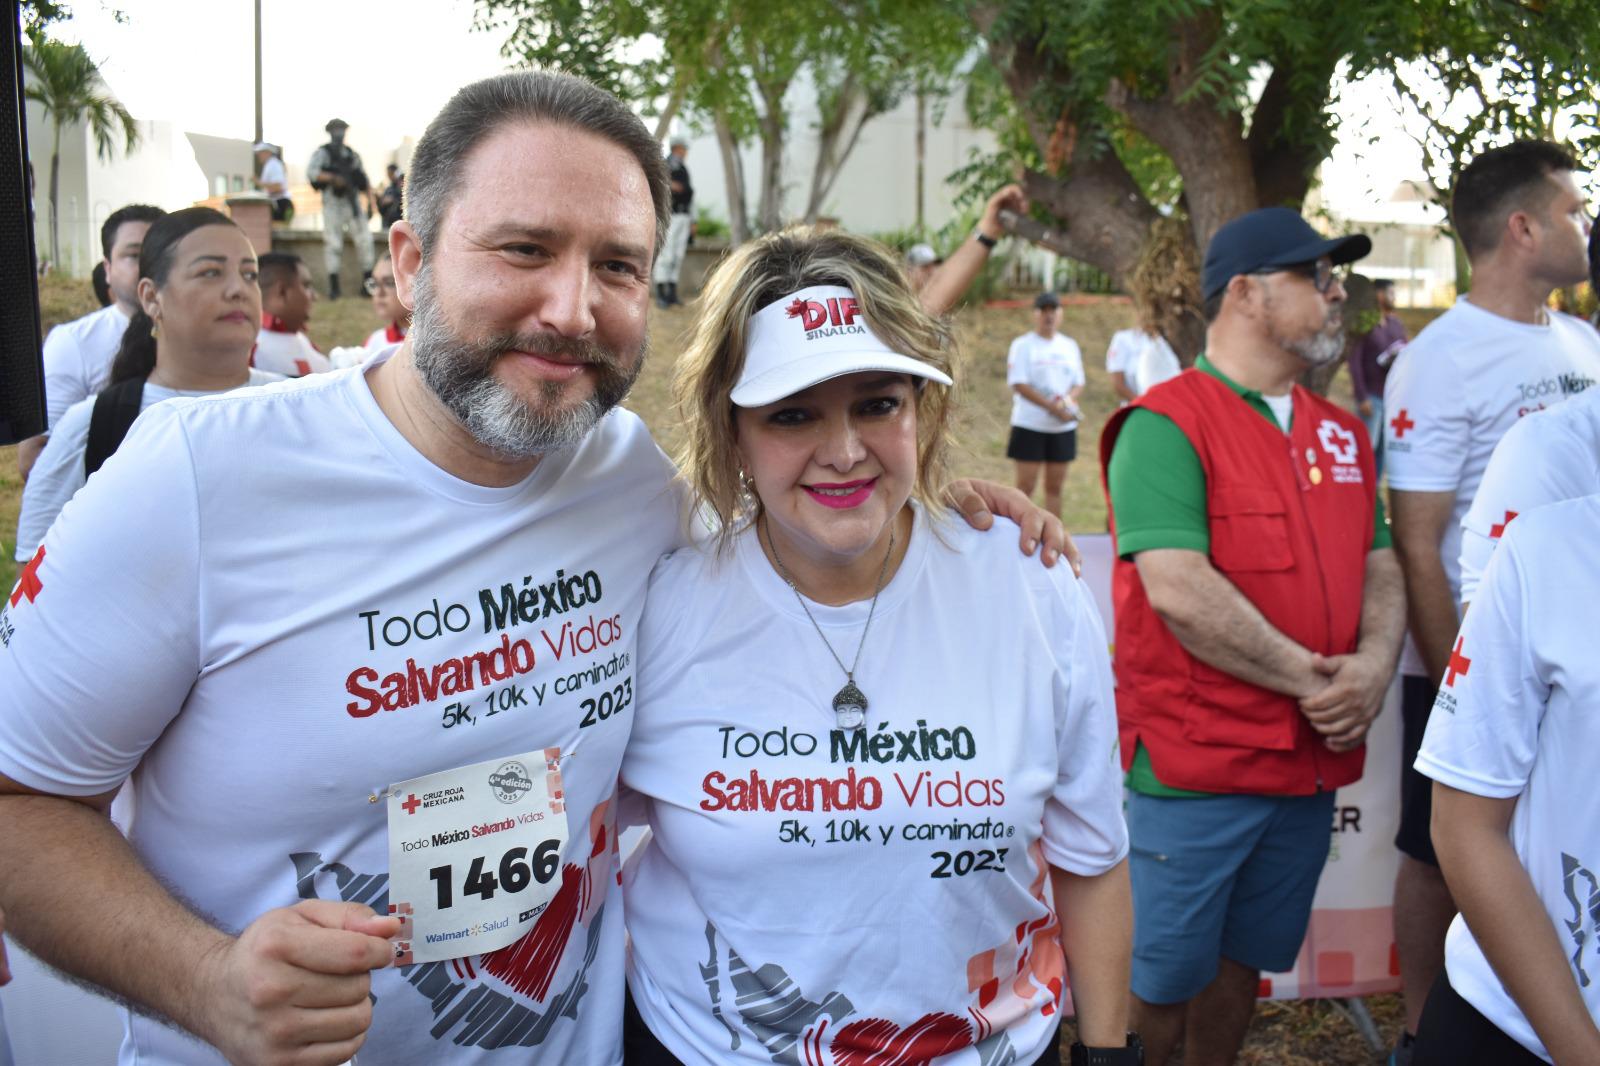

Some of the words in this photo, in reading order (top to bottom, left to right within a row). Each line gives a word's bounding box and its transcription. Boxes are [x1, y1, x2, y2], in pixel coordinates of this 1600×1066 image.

[800, 297, 864, 332] DIF
[806, 326, 866, 341] SINALOA
[359, 598, 470, 650] Todo
[478, 569, 602, 634] México
[345, 634, 536, 718] Salvando
[541, 613, 621, 661] Vidas
[442, 702, 478, 729] 5k,
[485, 685, 529, 717] 10k
[532, 682, 547, 706] y
[579, 676, 632, 728] 2023
[718, 726, 818, 758] Todo
[830, 719, 976, 763] México
[423, 790, 443, 801] CRUZ
[444, 786, 464, 796] ROJA
[423, 795, 465, 808] MEXICANA
[500, 777, 531, 789] edición
[699, 767, 883, 812] Salvando
[893, 770, 1006, 808] Vidas
[401, 838, 430, 852] Todo
[431, 829, 470, 848] México
[471, 817, 515, 838] Salvando
[516, 811, 544, 825] Vidas
[779, 820, 816, 847] 5k,
[825, 819, 872, 842] 10k
[878, 825, 895, 846] y
[429, 839, 561, 910] 1466
[930, 848, 1009, 878] 2023
[426, 928, 470, 943] Walmart
[482, 917, 509, 933] Salud
